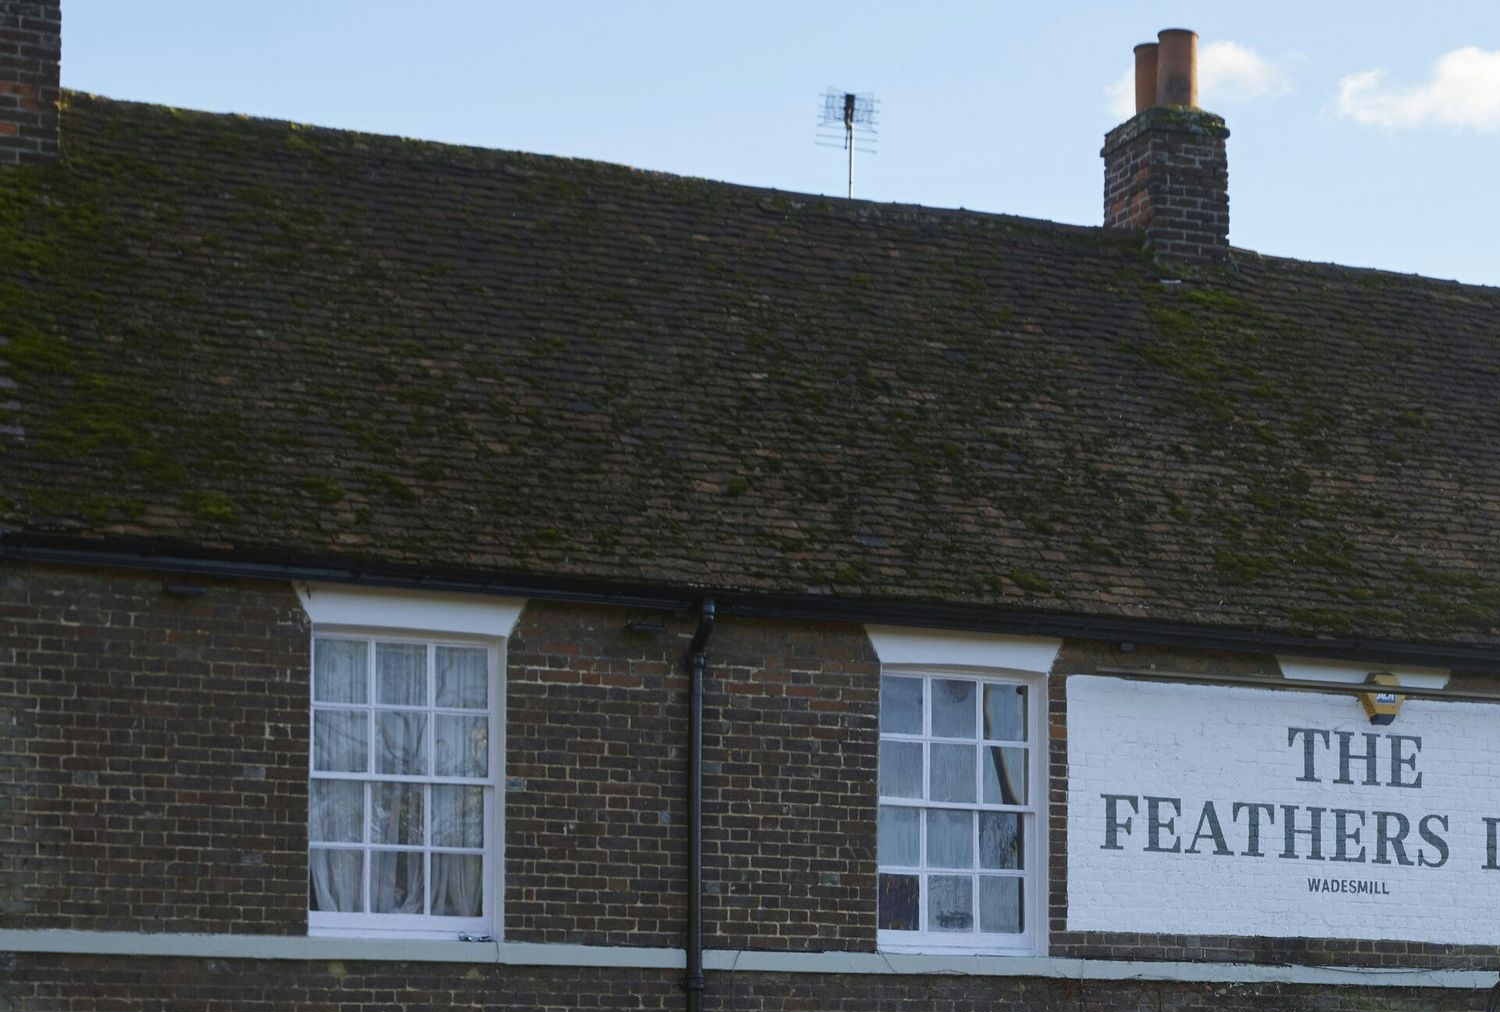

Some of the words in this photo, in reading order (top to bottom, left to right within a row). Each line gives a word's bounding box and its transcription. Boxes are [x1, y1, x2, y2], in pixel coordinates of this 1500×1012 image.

[1288, 727, 1423, 789] THE
[1100, 794, 1450, 868] FEATHERS
[1307, 877, 1390, 895] WADESMILL
